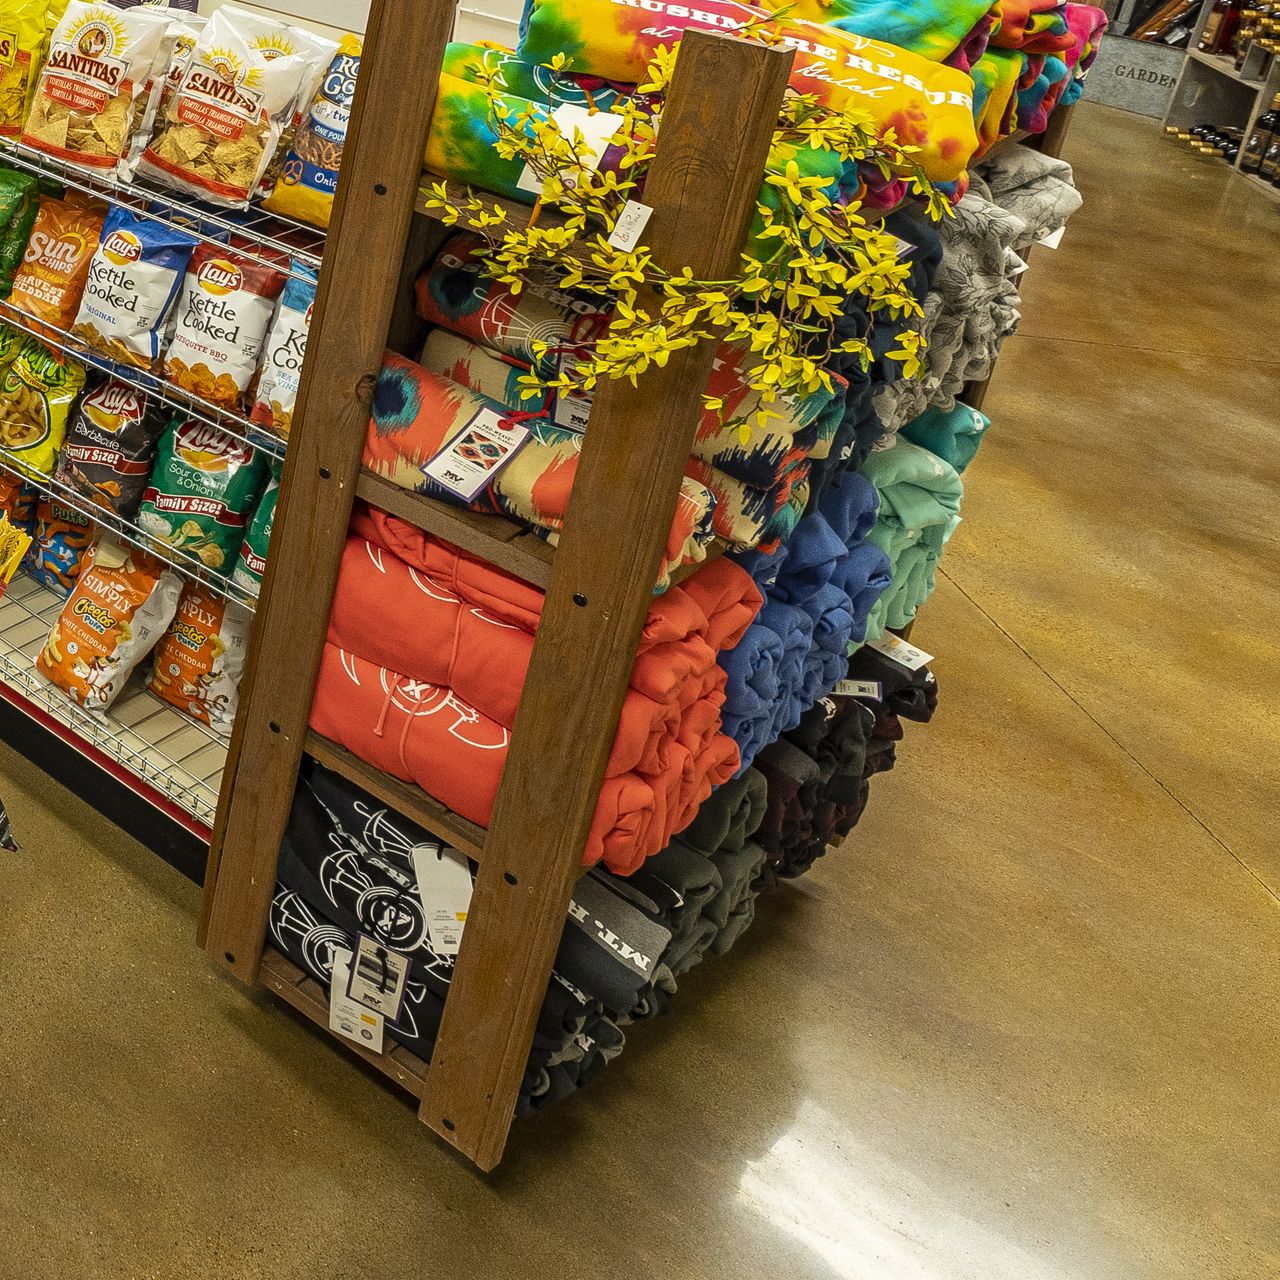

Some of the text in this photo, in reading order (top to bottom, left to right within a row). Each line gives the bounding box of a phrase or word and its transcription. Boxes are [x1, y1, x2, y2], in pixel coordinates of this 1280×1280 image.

[48, 49, 119, 85] SANTITAS
[48, 77, 106, 101] TORTILLAS TRIANGULARES
[51, 87, 96, 107] TORTILLA TRIANGLES
[183, 97, 244, 126] TORTILLAS TRIANGULARES
[184, 109, 232, 134] TORTILLA TRIANGLES
[24, 231, 80, 264] Sun
[103, 233, 140, 259] Lay's
[38, 254, 74, 274] CHIPS
[90, 258, 136, 291] Kettle
[199, 263, 241, 288] Lay's
[189, 290, 236, 321] Kettle
[183, 310, 240, 344] Cooked
[175, 332, 228, 362] MESQUITE BBQ
[74, 422, 120, 450] Barbecue
[92, 449, 120, 465] Size!
[155, 494, 223, 516] Family Size!
[73, 597, 115, 628] Cheetos
[78, 626, 108, 654] CHEDDAR
